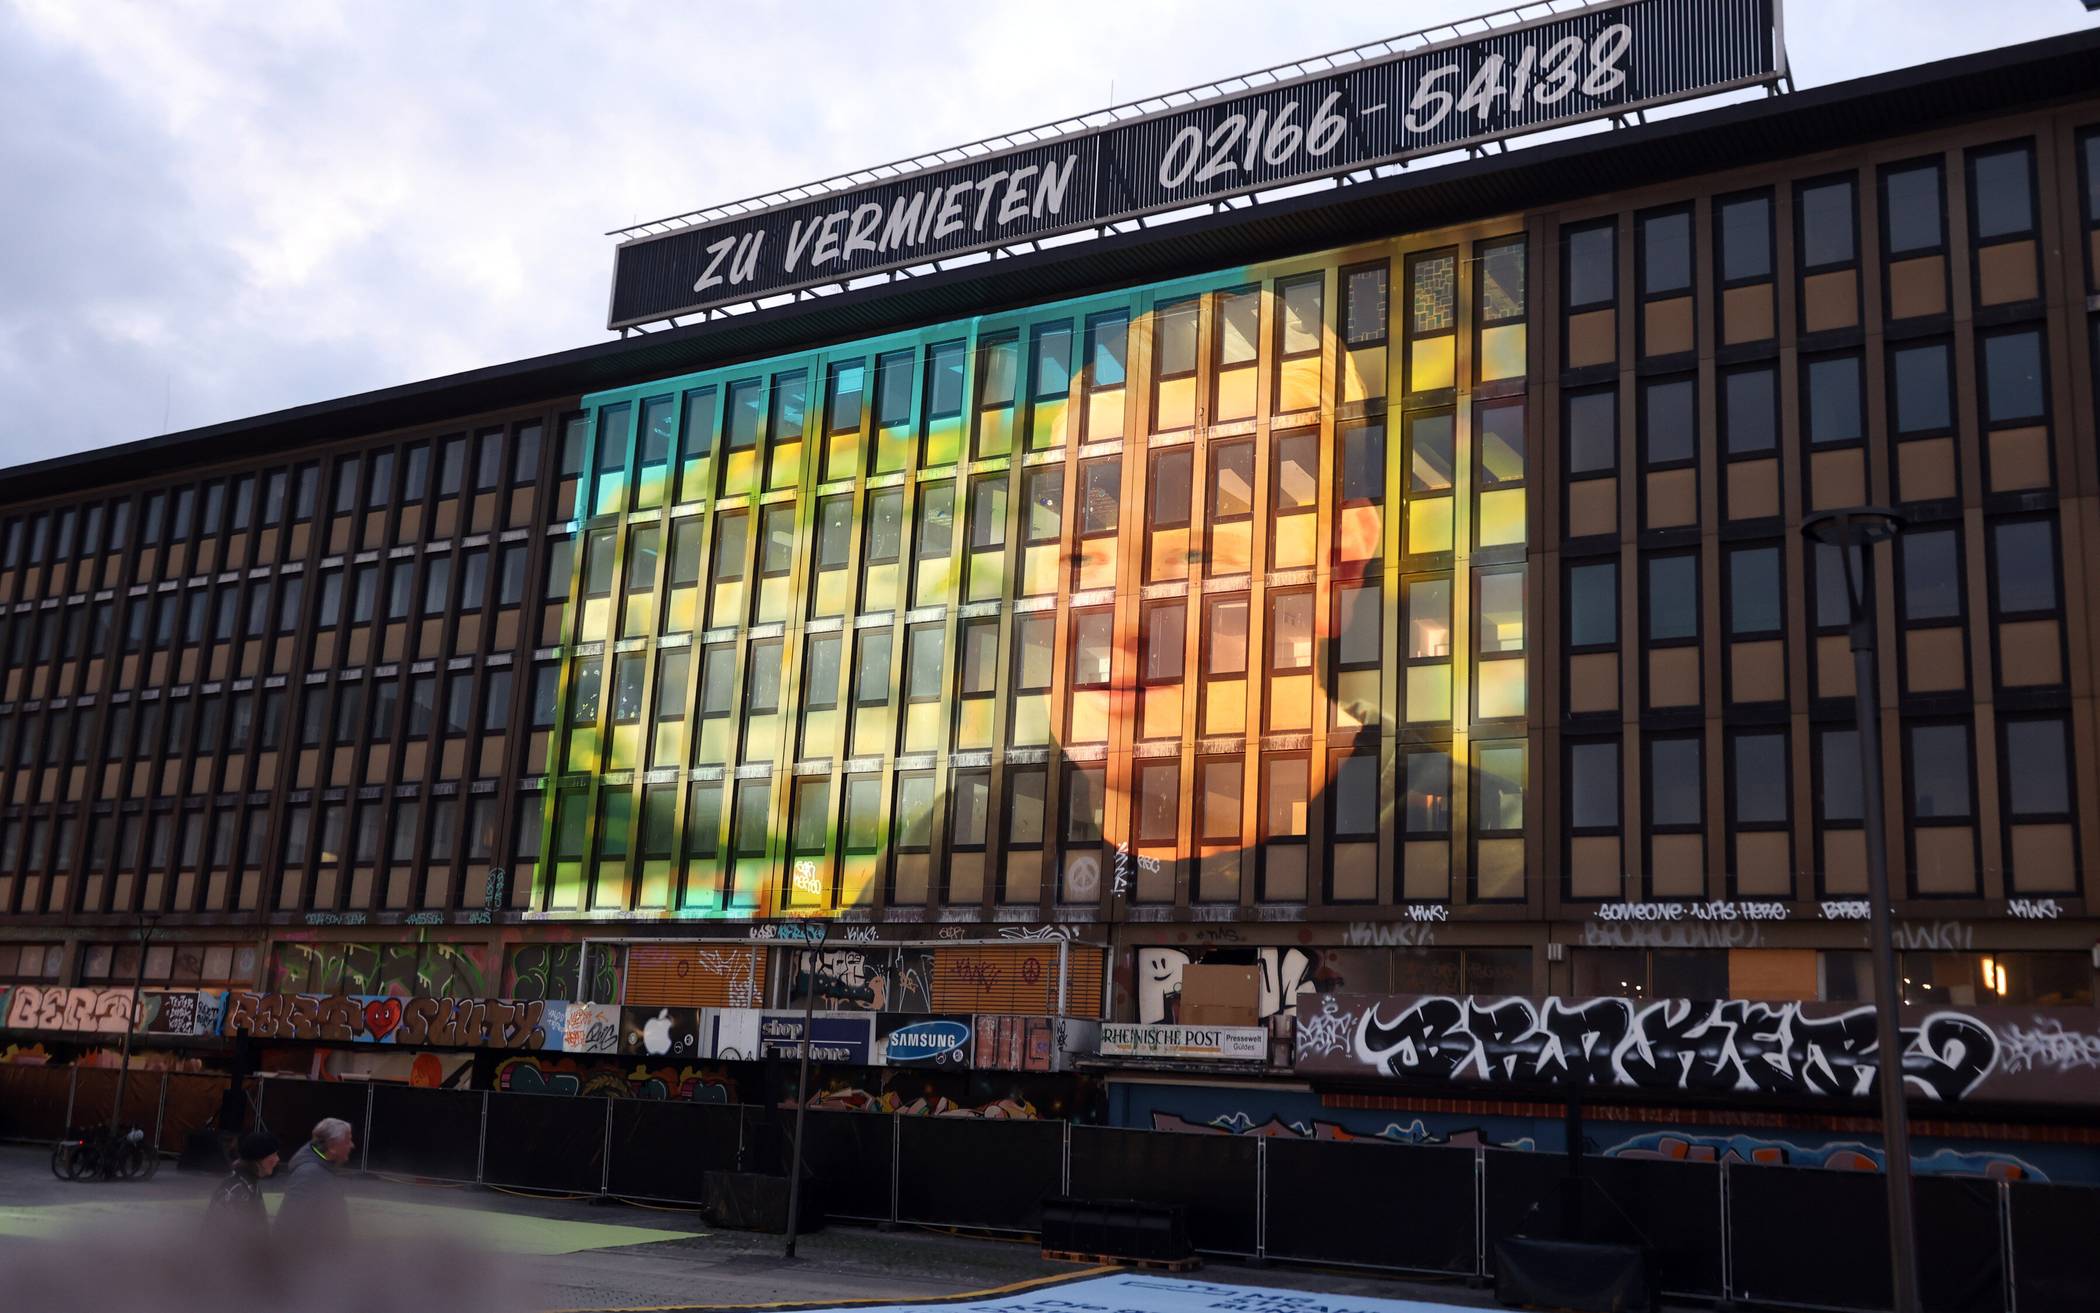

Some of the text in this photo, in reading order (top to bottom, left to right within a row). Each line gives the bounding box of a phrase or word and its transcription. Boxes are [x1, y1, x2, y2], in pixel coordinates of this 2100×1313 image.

[694, 230, 766, 292] ZU
[785, 154, 1077, 273] VERMIETEN
[1158, 92, 1347, 190] 02166
[1404, 23, 1632, 134] 54138
[762, 1018, 803, 1040] shop
[1103, 1028, 1222, 1047] RHEINISCHE POST
[890, 1032, 956, 1048] SAMSUNG
